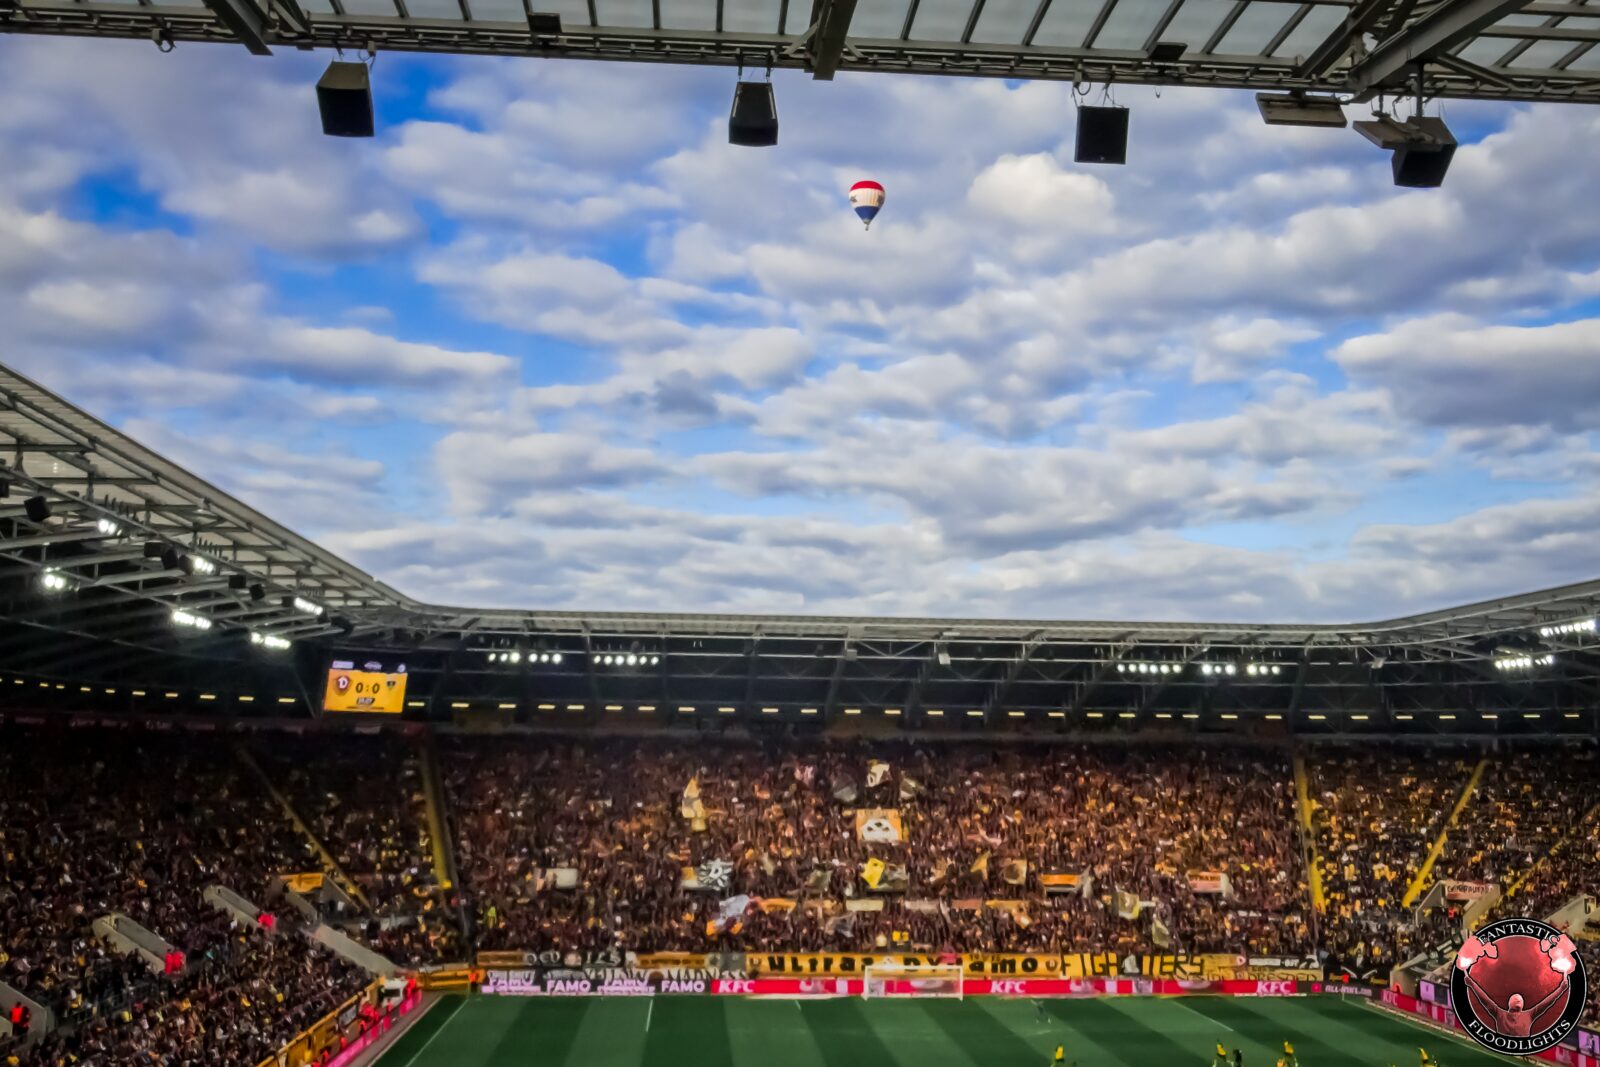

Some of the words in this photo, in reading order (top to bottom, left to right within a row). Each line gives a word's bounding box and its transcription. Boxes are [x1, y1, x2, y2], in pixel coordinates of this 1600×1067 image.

[547, 979, 591, 993] FAMO
[661, 980, 705, 993] FAMO
[718, 980, 755, 993] KFC
[990, 980, 1027, 993] KFC
[1256, 981, 1291, 993] KFC
